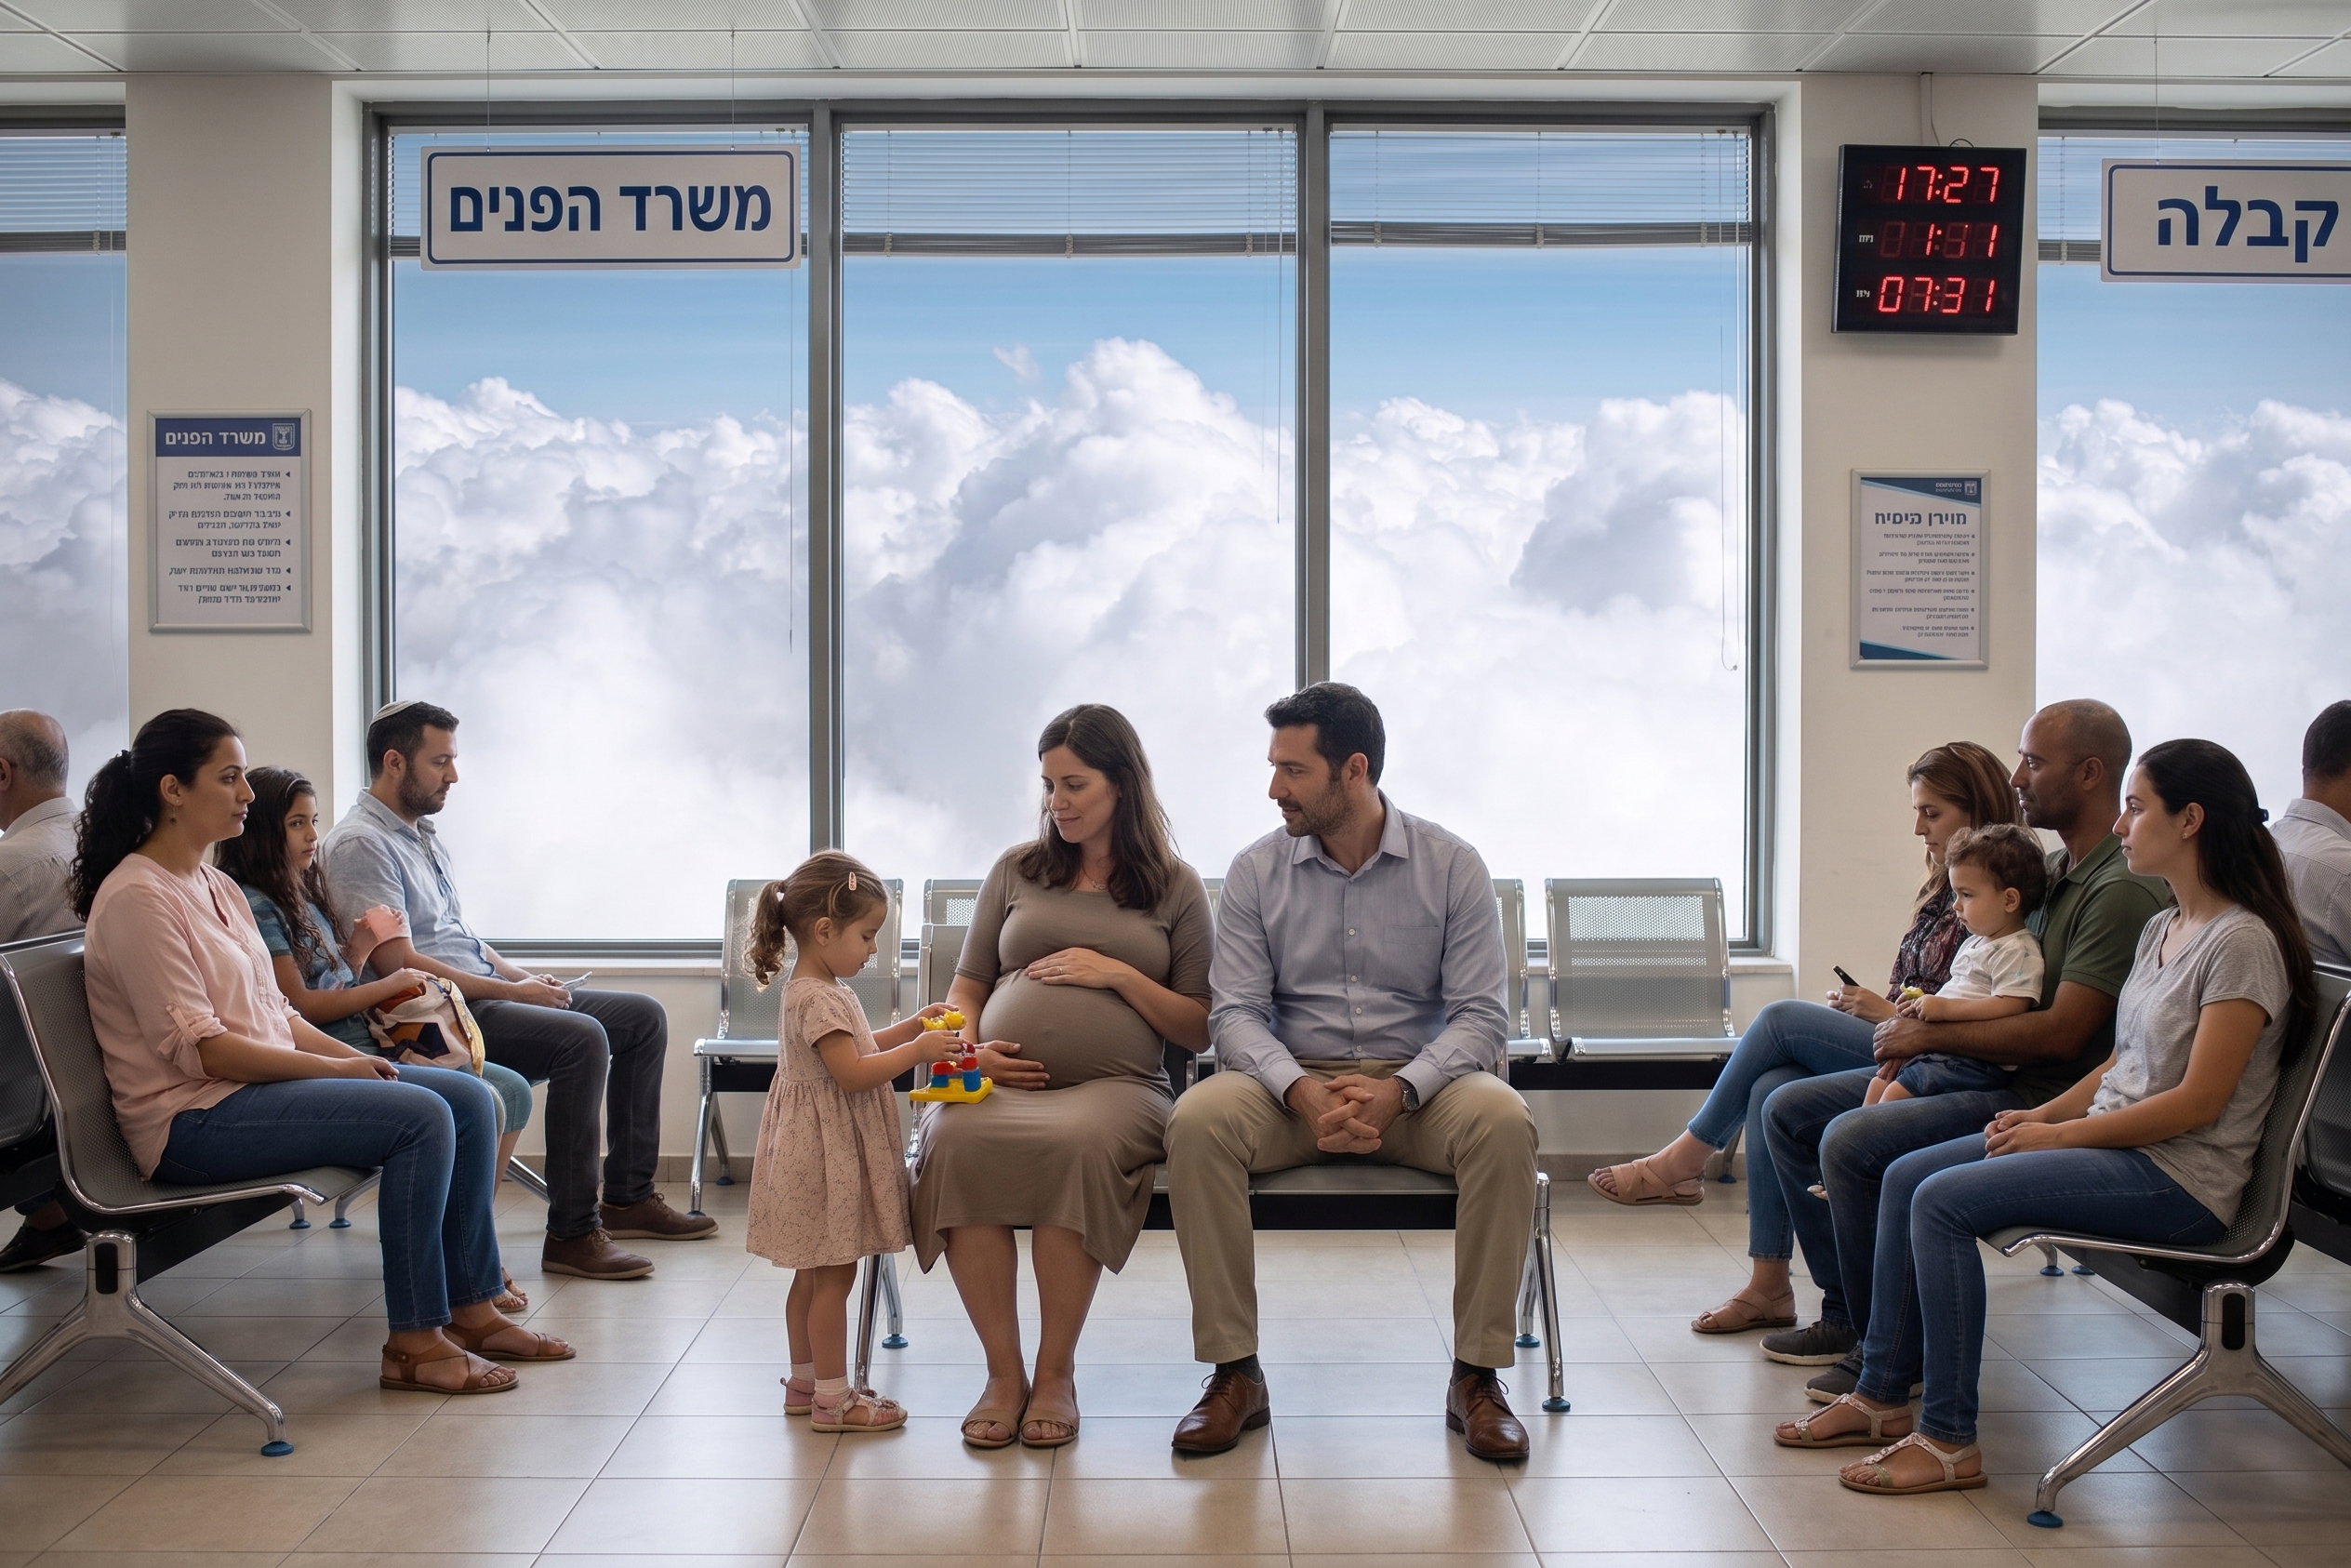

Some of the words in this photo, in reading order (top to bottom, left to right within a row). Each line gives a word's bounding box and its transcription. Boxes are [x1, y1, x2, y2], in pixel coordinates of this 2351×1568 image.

[1897, 166, 1999, 203] 17:27
[450, 186, 601, 233] הפנים
[619, 185, 772, 232] משרד
[2158, 186, 2339, 263] קבלה
[1878, 276, 1996, 312] 07:31
[165, 432, 213, 445] הפנים
[219, 431, 267, 445] משרד
